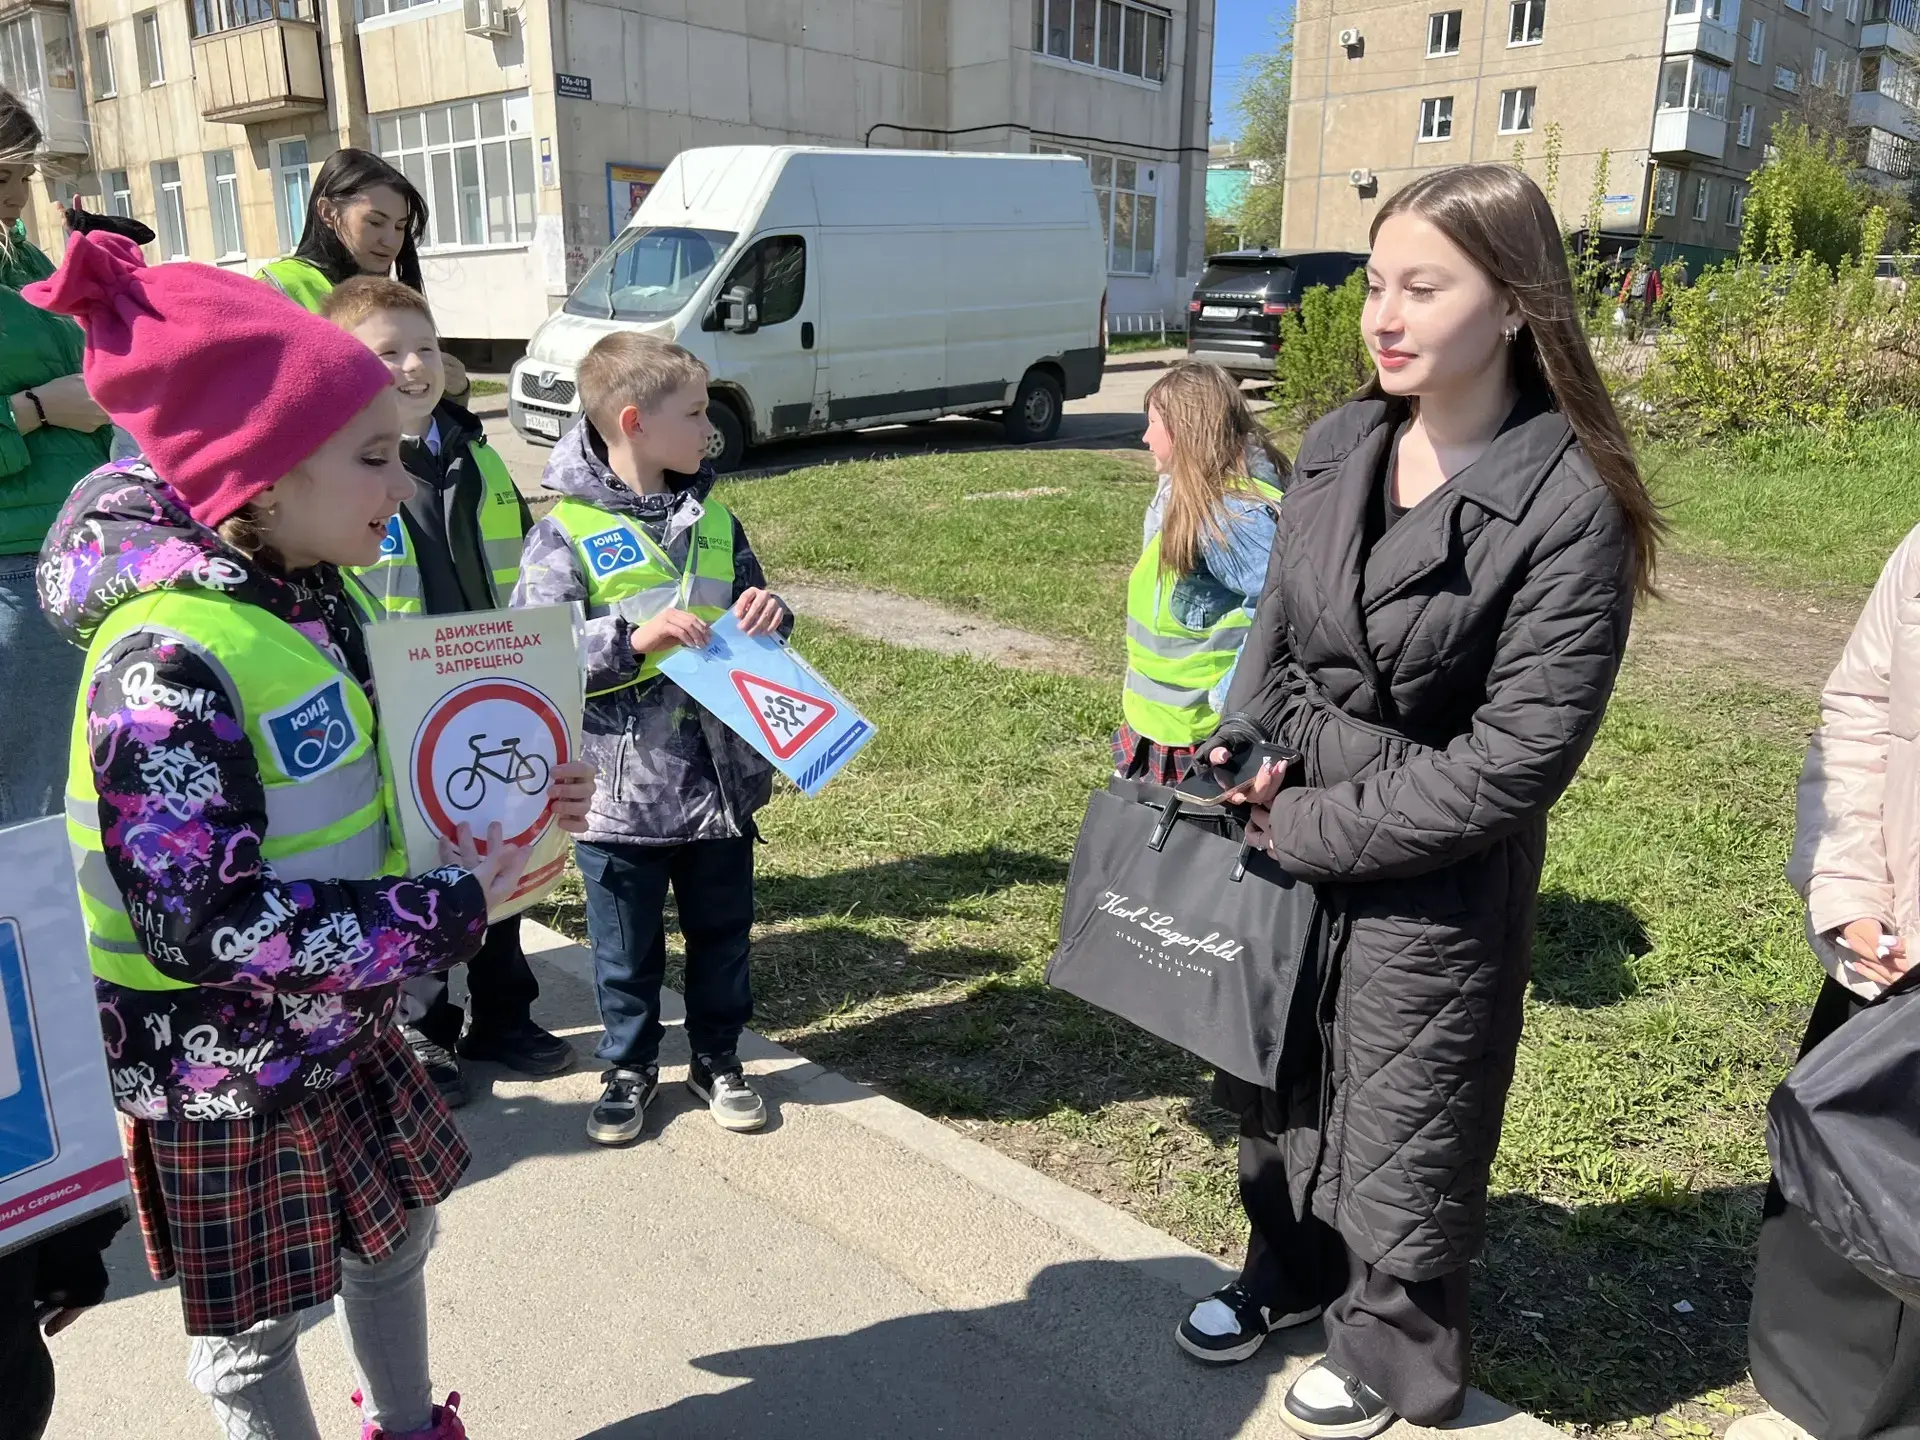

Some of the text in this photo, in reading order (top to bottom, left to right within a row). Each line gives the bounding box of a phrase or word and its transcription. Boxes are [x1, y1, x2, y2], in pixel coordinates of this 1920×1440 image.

[593, 532, 624, 548] ЮИД
[94, 563, 139, 606] BEST
[408, 633, 542, 661] НА ВЕЛОСИПЕДАХ
[434, 620, 514, 643] ДВИЖЕНИЕ
[435, 652, 524, 675] ЗАПРЕЩЕНО
[290, 696, 330, 731] ЮИД
[1098, 891, 1244, 962] Karl Lagerfeld
[1126, 935, 1142, 948] RUE
[1158, 952, 1213, 977] GULLAUME
[0, 1183, 82, 1222] НАК СЕРВИСА
